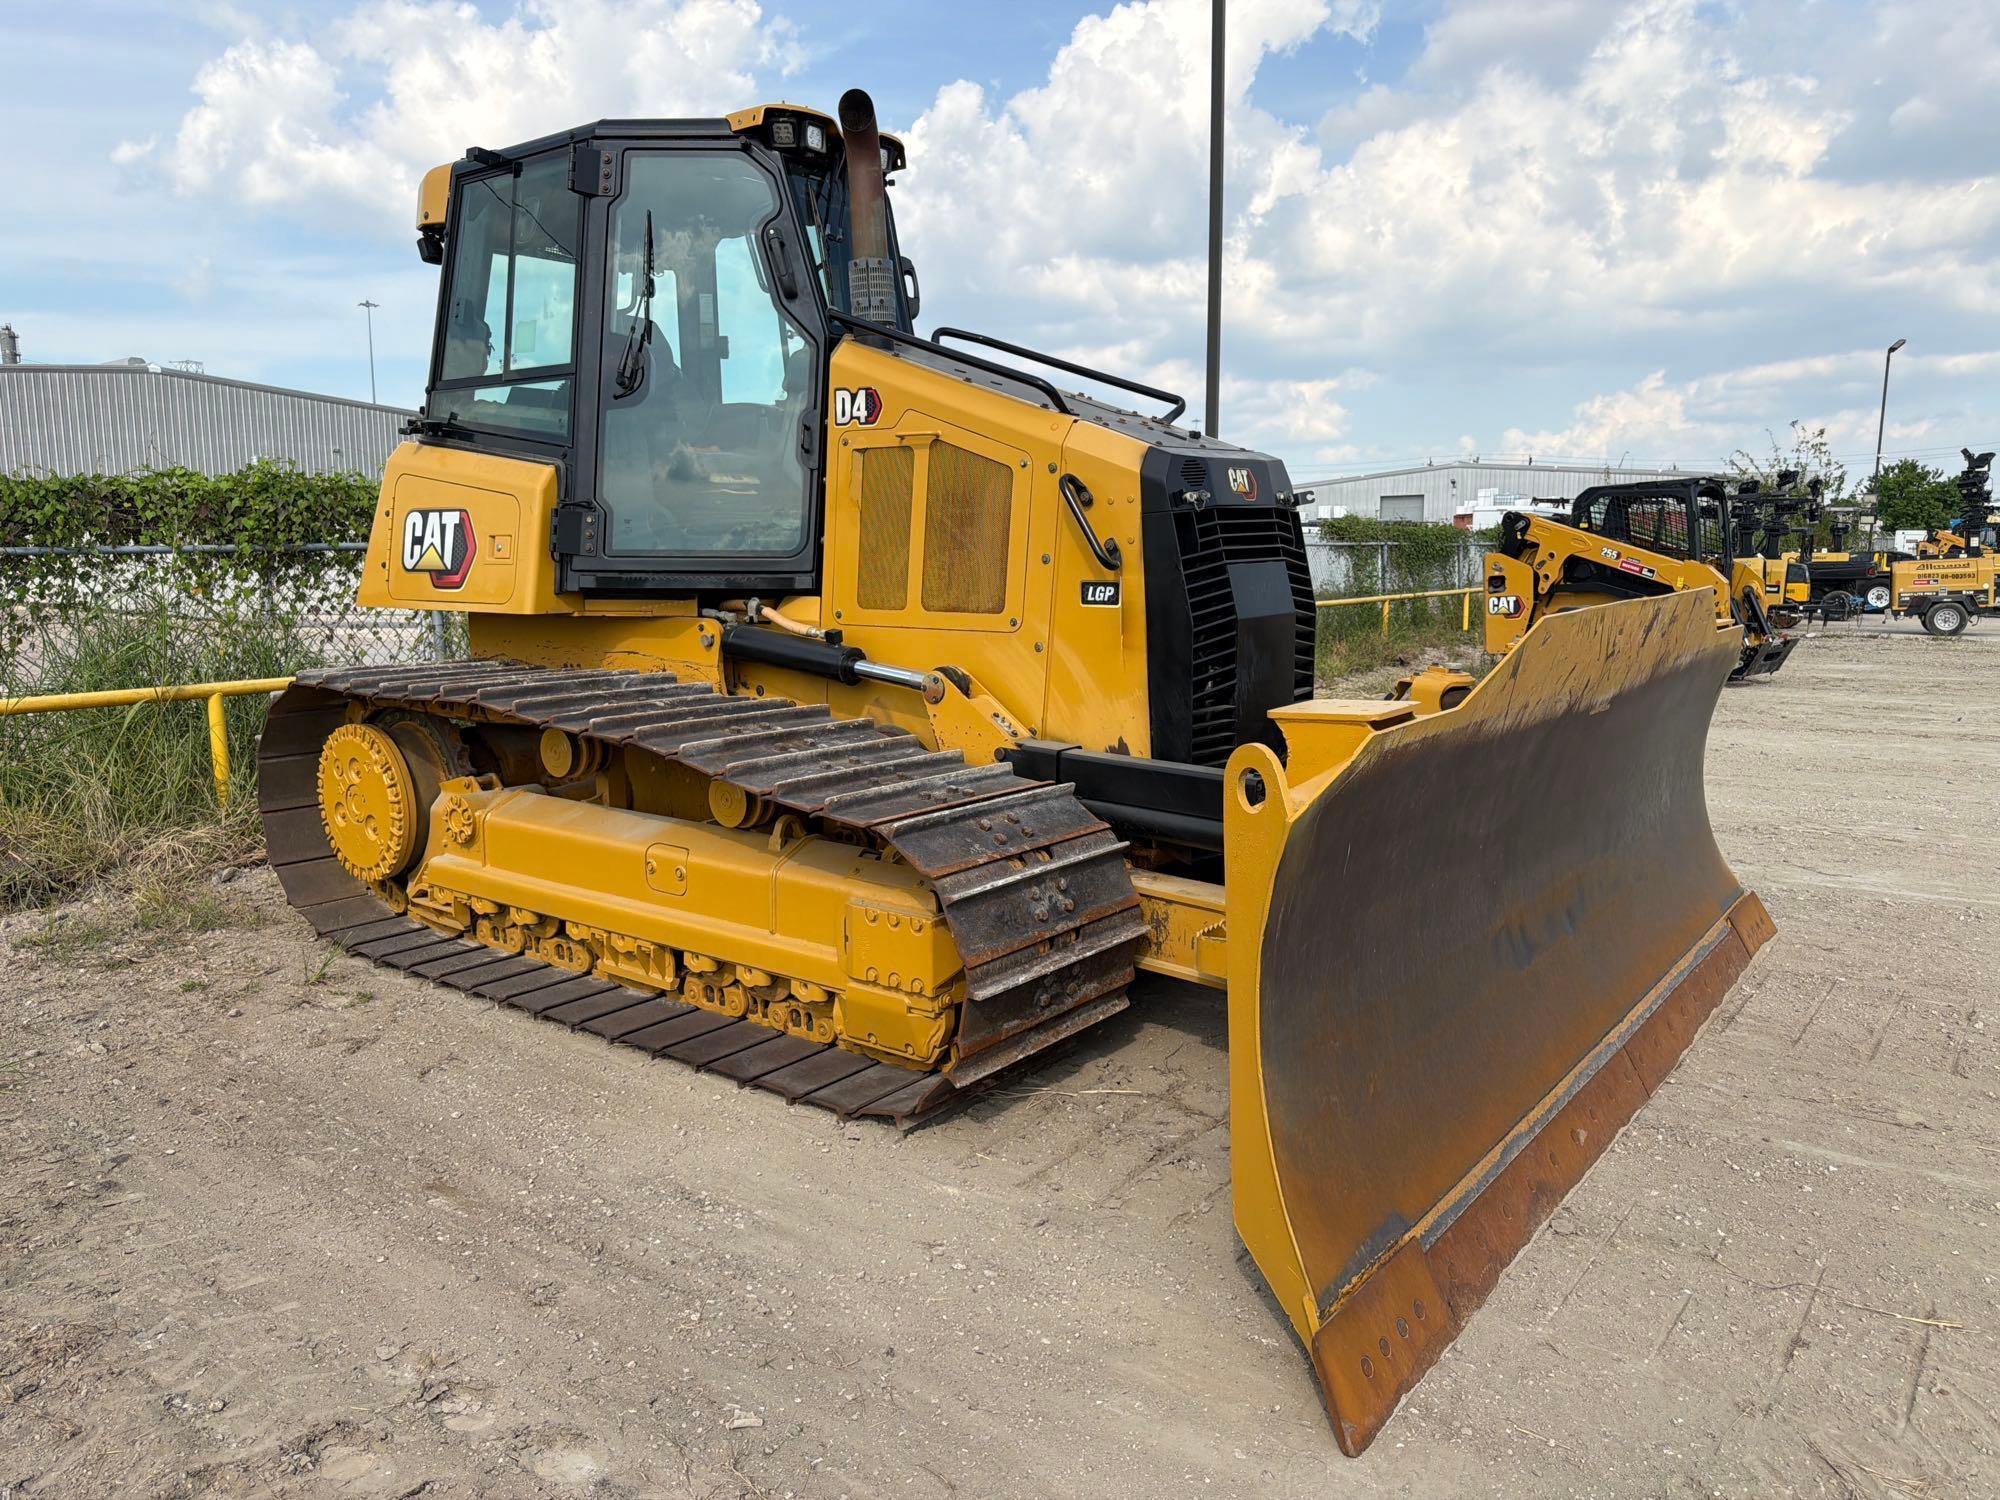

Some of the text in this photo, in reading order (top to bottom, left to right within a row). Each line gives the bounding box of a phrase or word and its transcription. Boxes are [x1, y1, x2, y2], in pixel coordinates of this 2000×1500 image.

[835, 389, 868, 424] D4
[1228, 467, 1250, 492] CAT
[403, 511, 460, 570] CAT
[1601, 547, 1618, 560] 255
[1087, 585, 1115, 601] LGP
[1488, 596, 1517, 614] CAT
